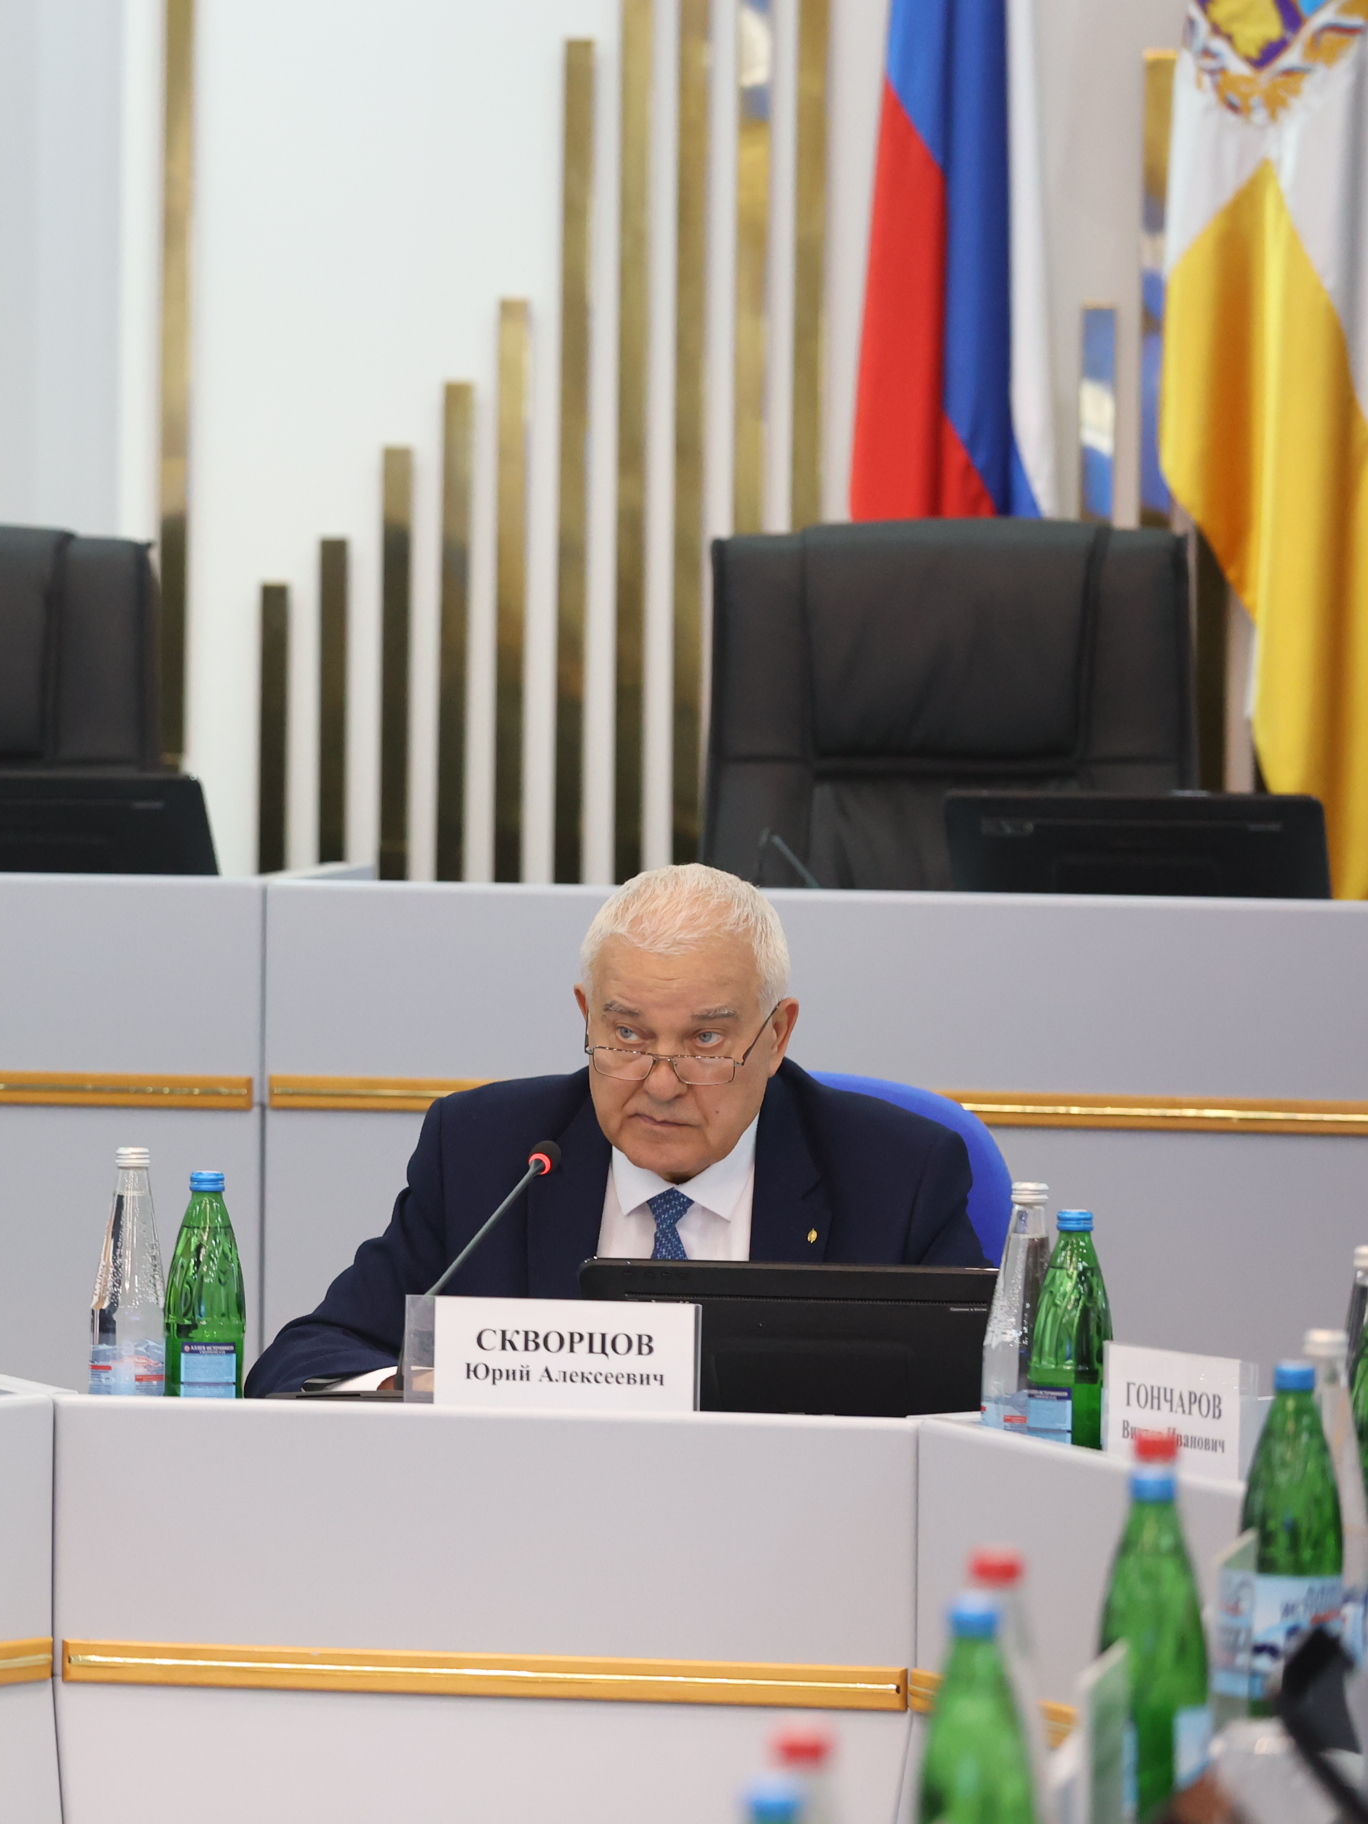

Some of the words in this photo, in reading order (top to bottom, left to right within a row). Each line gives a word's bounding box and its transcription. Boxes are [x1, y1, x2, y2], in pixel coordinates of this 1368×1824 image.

[476, 1328, 655, 1360] СКВОРЦОВ
[465, 1362, 531, 1386] Юрий
[539, 1366, 665, 1386] Алексеевич
[1126, 1381, 1222, 1420] ГОНЧАРОВ
